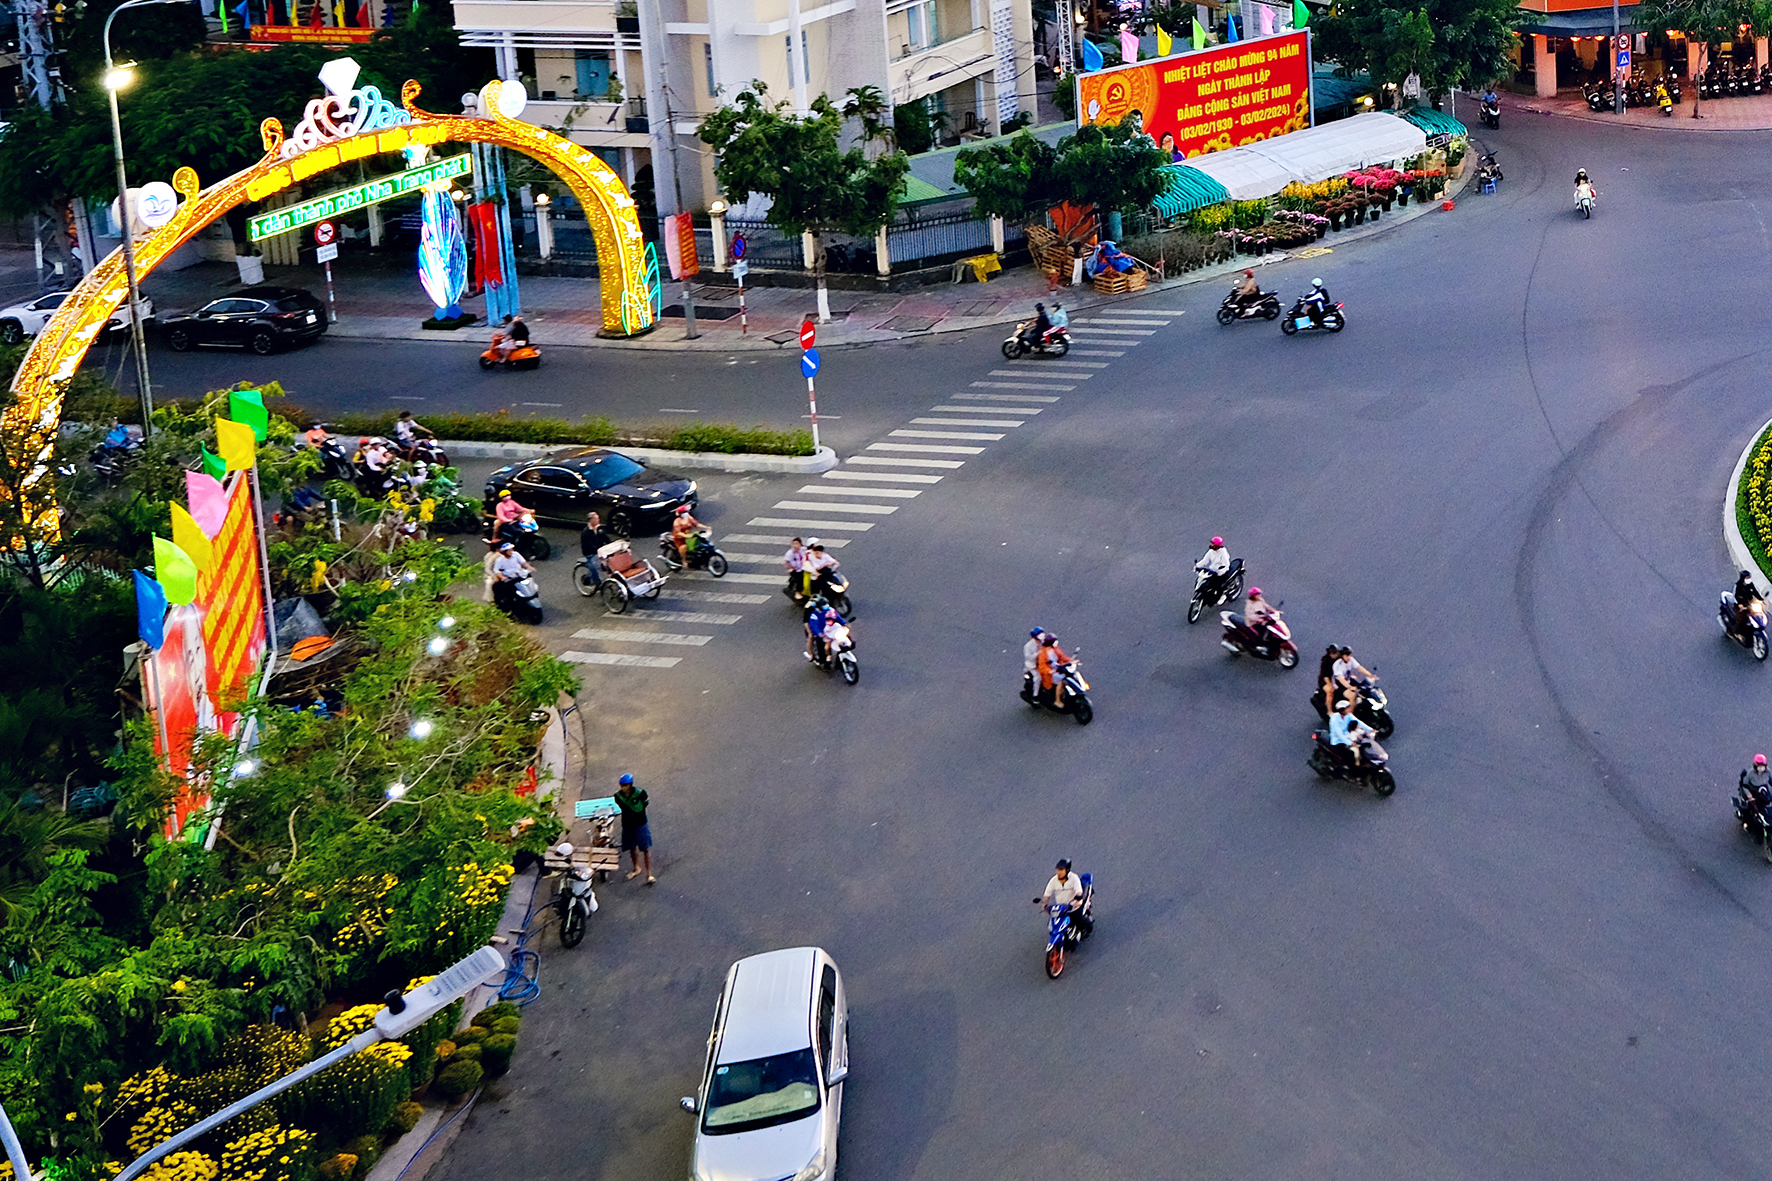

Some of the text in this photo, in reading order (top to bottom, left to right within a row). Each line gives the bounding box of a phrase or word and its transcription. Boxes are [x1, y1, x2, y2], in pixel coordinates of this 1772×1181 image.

[1164, 43, 1299, 84] NHIỆT LIỆT CHÀO MỪNG 94 NĂM
[1198, 68, 1271, 97] NGÀY THÀNH LẬP
[1177, 83, 1291, 121] ĐẢNG CỘNG SẢN VIỆT NAM
[1180, 117, 1233, 141] (03/02/1930
[1240, 103, 1290, 126] 03/02/2024)
[364, 183, 392, 202] Nha
[393, 169, 432, 192] Trang
